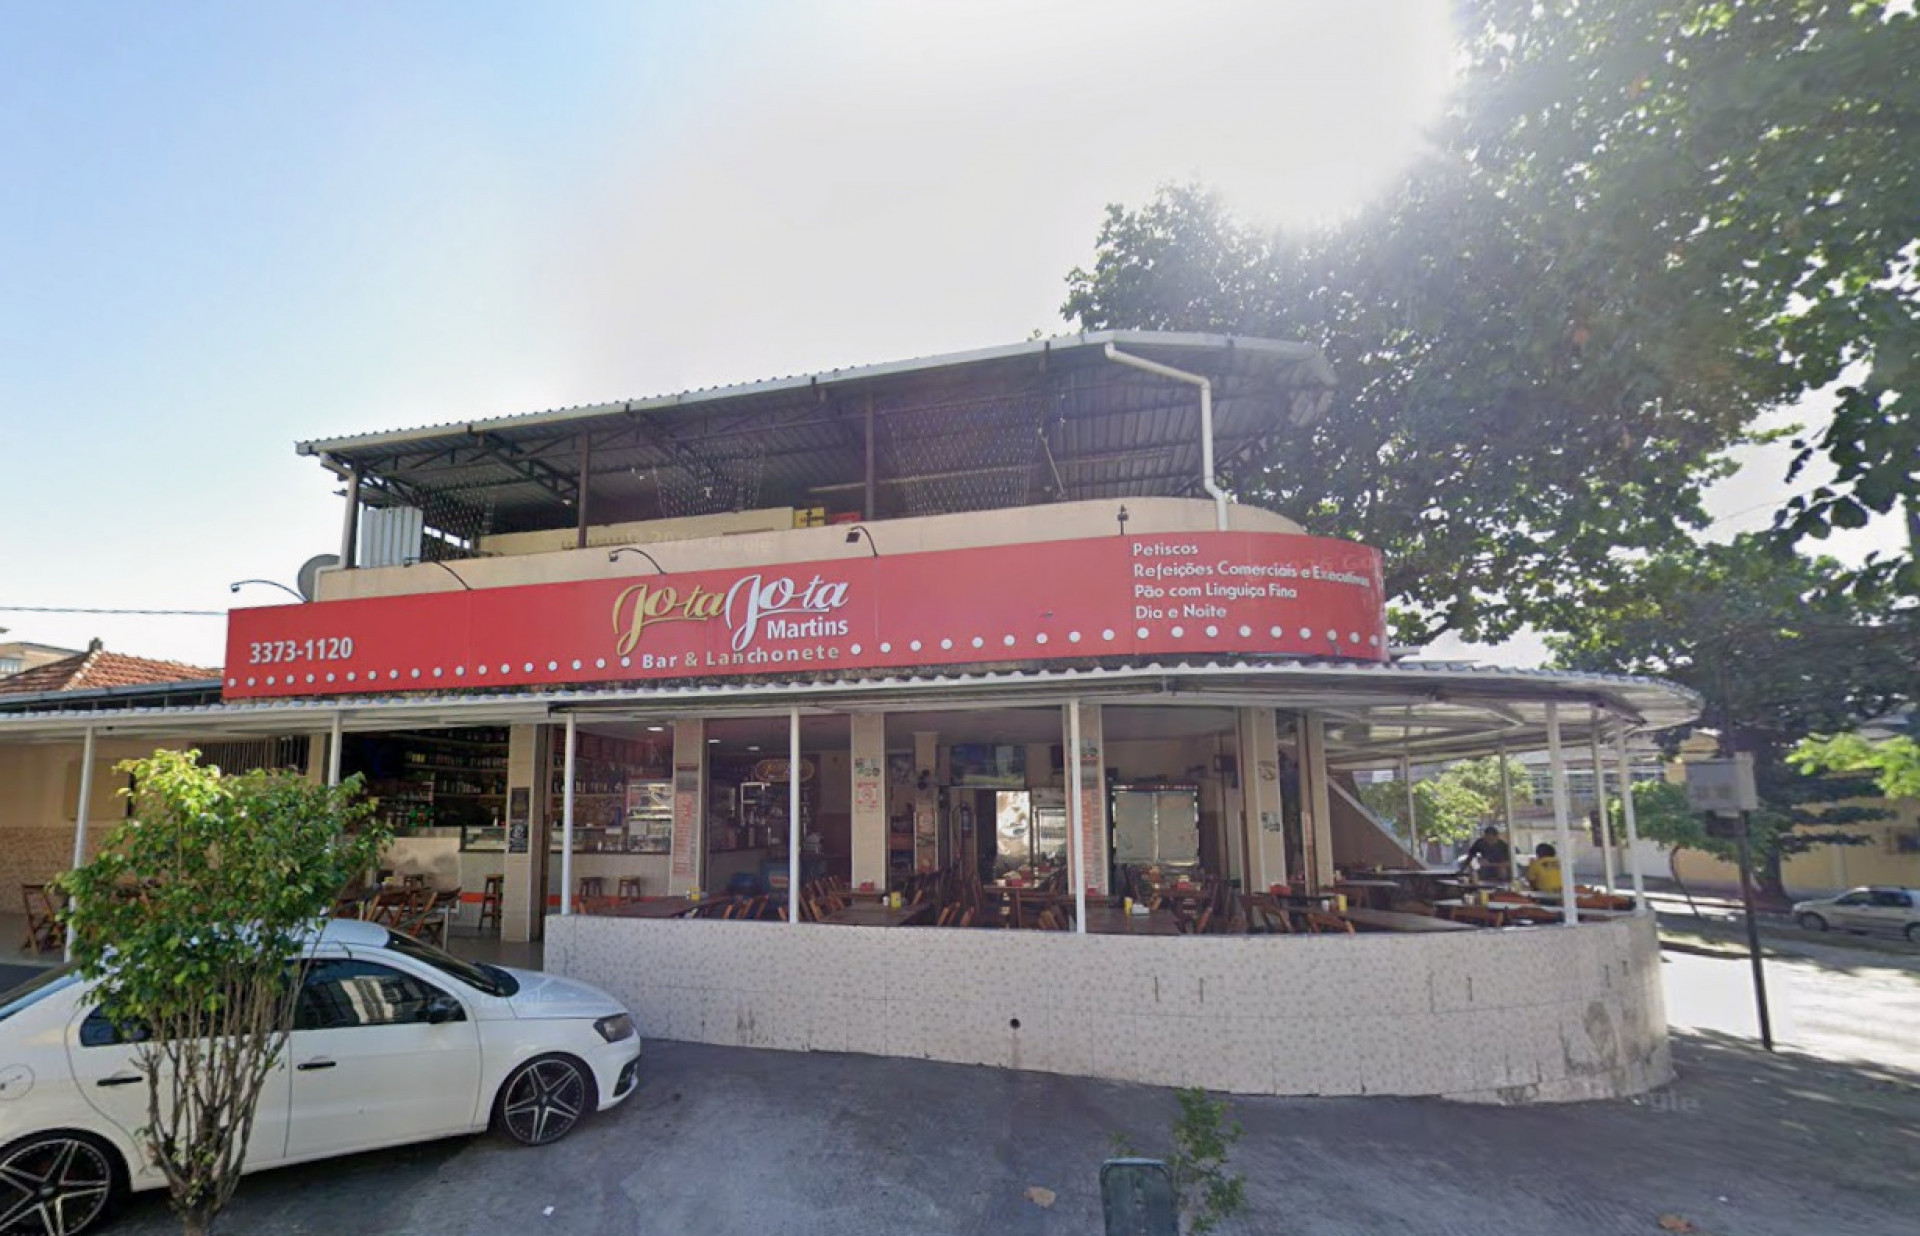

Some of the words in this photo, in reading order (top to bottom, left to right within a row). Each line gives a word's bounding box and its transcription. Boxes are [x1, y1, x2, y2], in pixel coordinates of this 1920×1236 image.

[1132, 542, 1198, 556] Petiscos
[1134, 562, 1214, 580] Refeições
[1217, 560, 1298, 578] Comerciais
[1301, 568, 1310, 578] e
[1134, 584, 1165, 598] Pão
[1168, 586, 1202, 597] com
[1205, 581, 1265, 600] Linguiça
[1268, 583, 1298, 598] Fina
[1135, 604, 1163, 619] Dia
[1168, 608, 1178, 618] e
[1183, 603, 1228, 618] Noite
[767, 616, 849, 640] Martins
[249, 636, 353, 664] 3373-1120
[642, 650, 677, 669] Bar
[685, 652, 698, 667] &
[706, 644, 839, 666] Lanchonete
